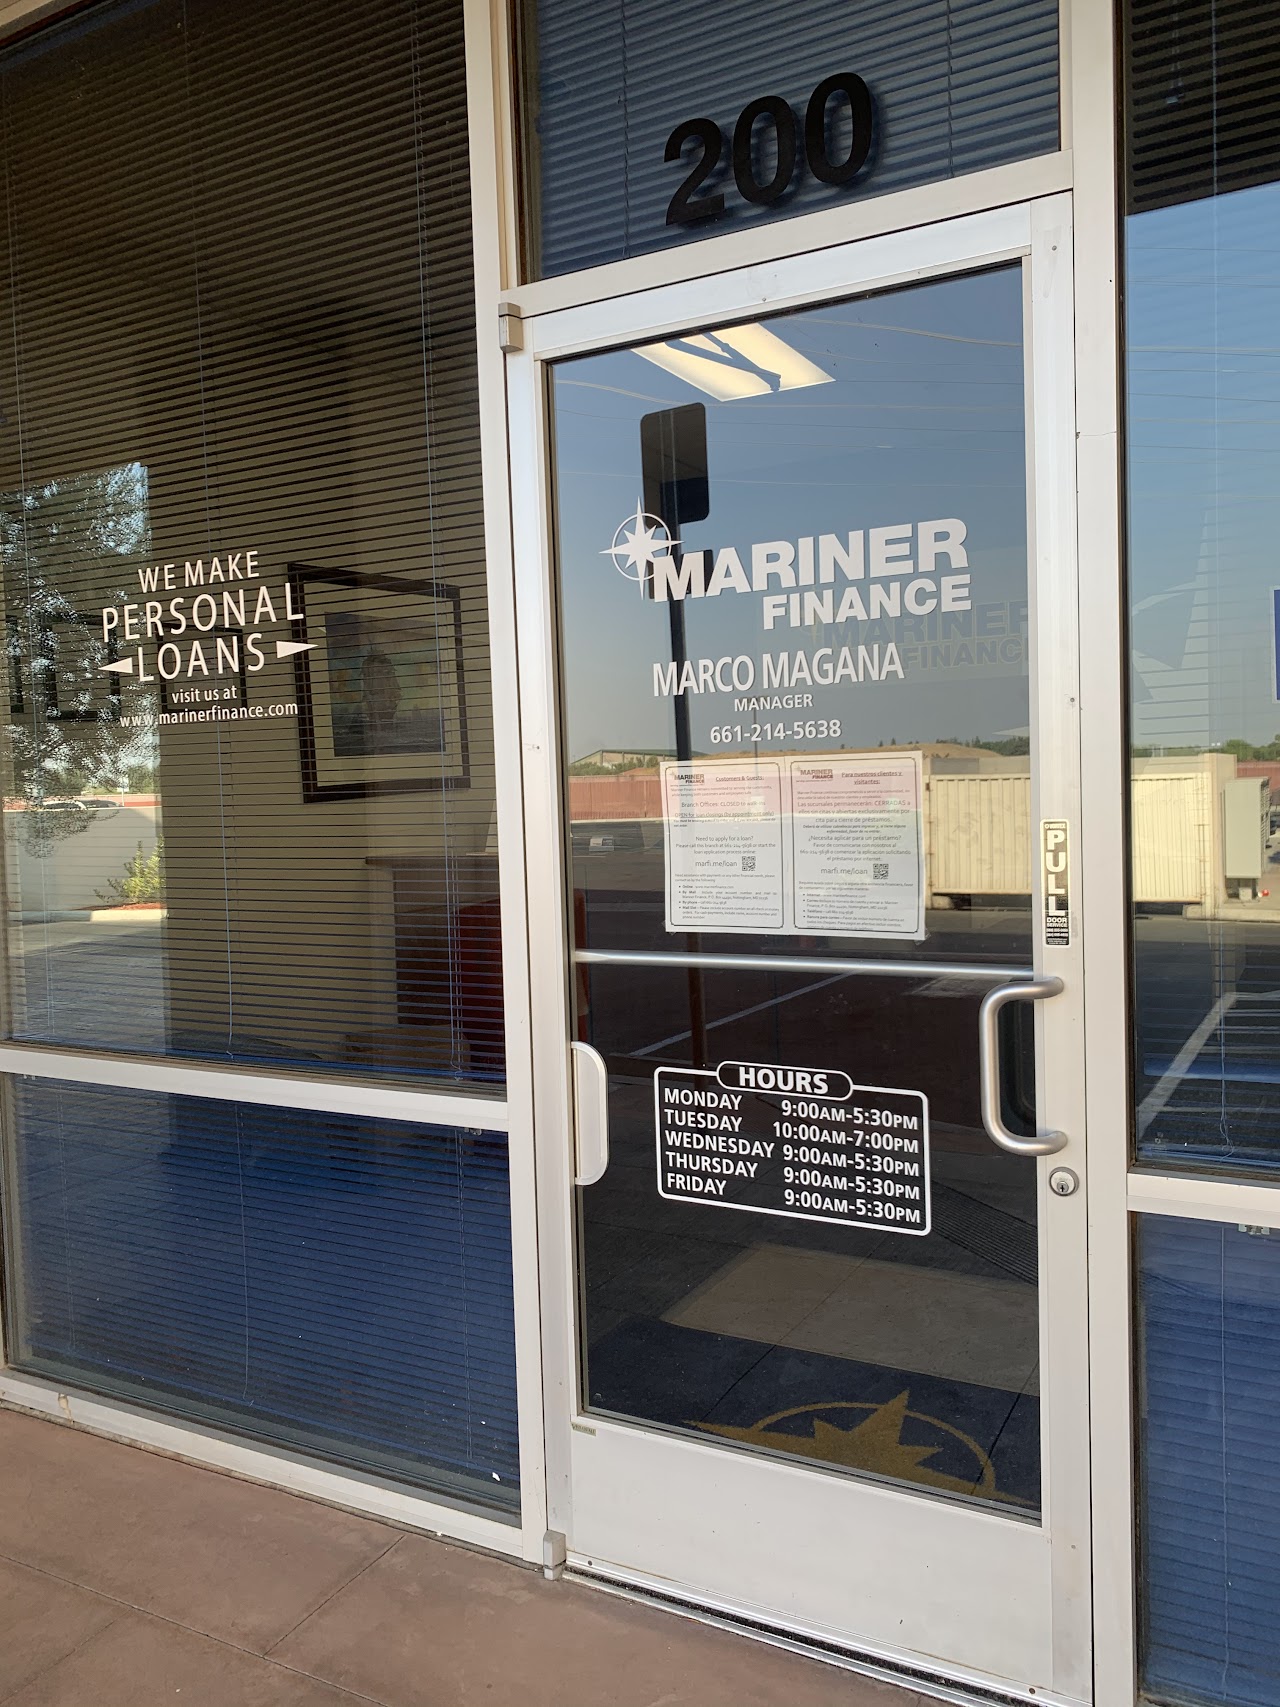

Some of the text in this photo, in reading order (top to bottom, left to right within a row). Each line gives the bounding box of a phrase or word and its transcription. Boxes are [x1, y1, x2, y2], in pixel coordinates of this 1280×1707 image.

[664, 72, 872, 226] 200
[138, 551, 260, 593] WE MAKE
[653, 518, 969, 603] MARINER
[102, 582, 304, 643] PERSONAL
[763, 574, 972, 630] FINANCE
[138, 632, 265, 682] LOANS
[653, 642, 904, 697] MARCO MAGANA
[120, 703, 298, 727] www.marinerfinance.com
[172, 685, 237, 704] visit us at
[734, 693, 814, 712] MANAGER
[710, 719, 842, 743] 661-214-5638
[1046, 830, 1066, 916] PULL
[739, 1066, 829, 1095] HOURS
[664, 1087, 918, 1130] MONDAY 9:00AM-5:30PM
[664, 1109, 919, 1154] TUESDAY 10:00AM-7:00PM
[665, 1130, 919, 1177] WEDNESDAY 9:00AM-5:30PM
[666, 1151, 920, 1200] THURSDAY 9:00AM-5:30PM
[667, 1172, 921, 1223] FRIDAY 9:00AM-5:30PM
